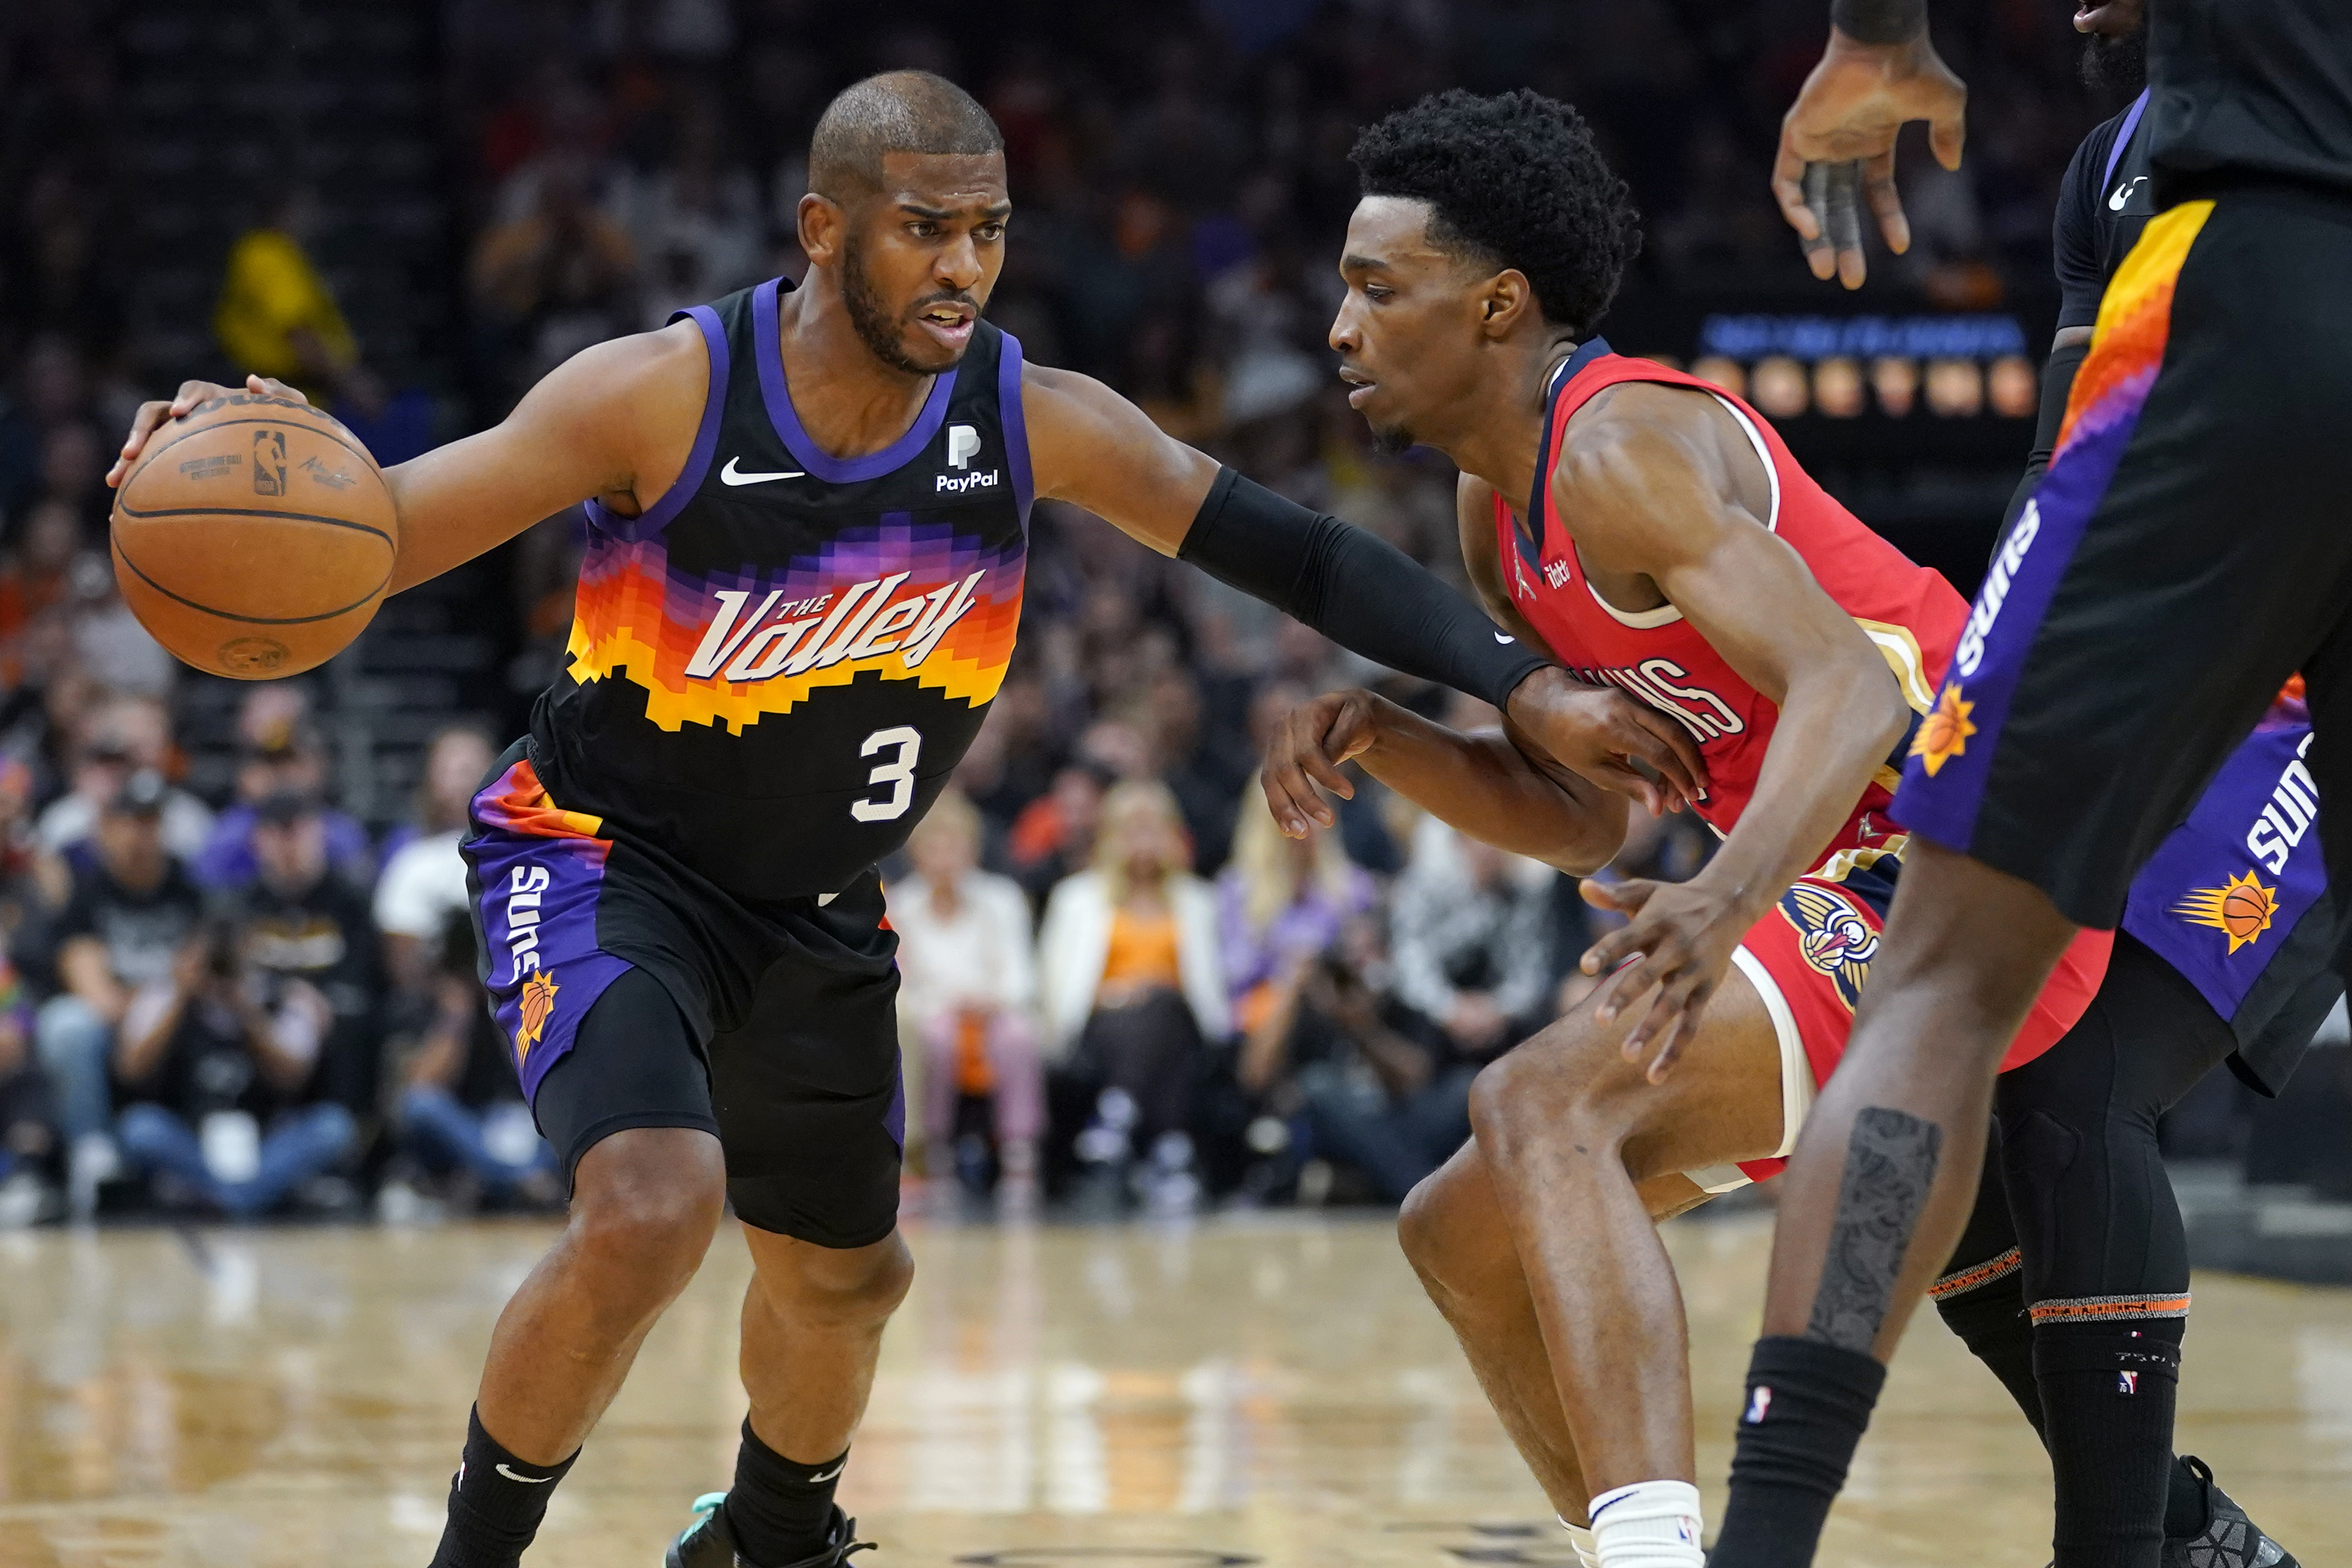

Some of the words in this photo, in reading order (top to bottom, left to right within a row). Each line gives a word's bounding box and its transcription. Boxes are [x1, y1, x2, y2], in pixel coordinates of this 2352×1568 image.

[936, 469, 998, 493] PayPal
[684, 569, 987, 684] Valley
[777, 593, 834, 620] THE
[849, 725, 923, 823] 3
